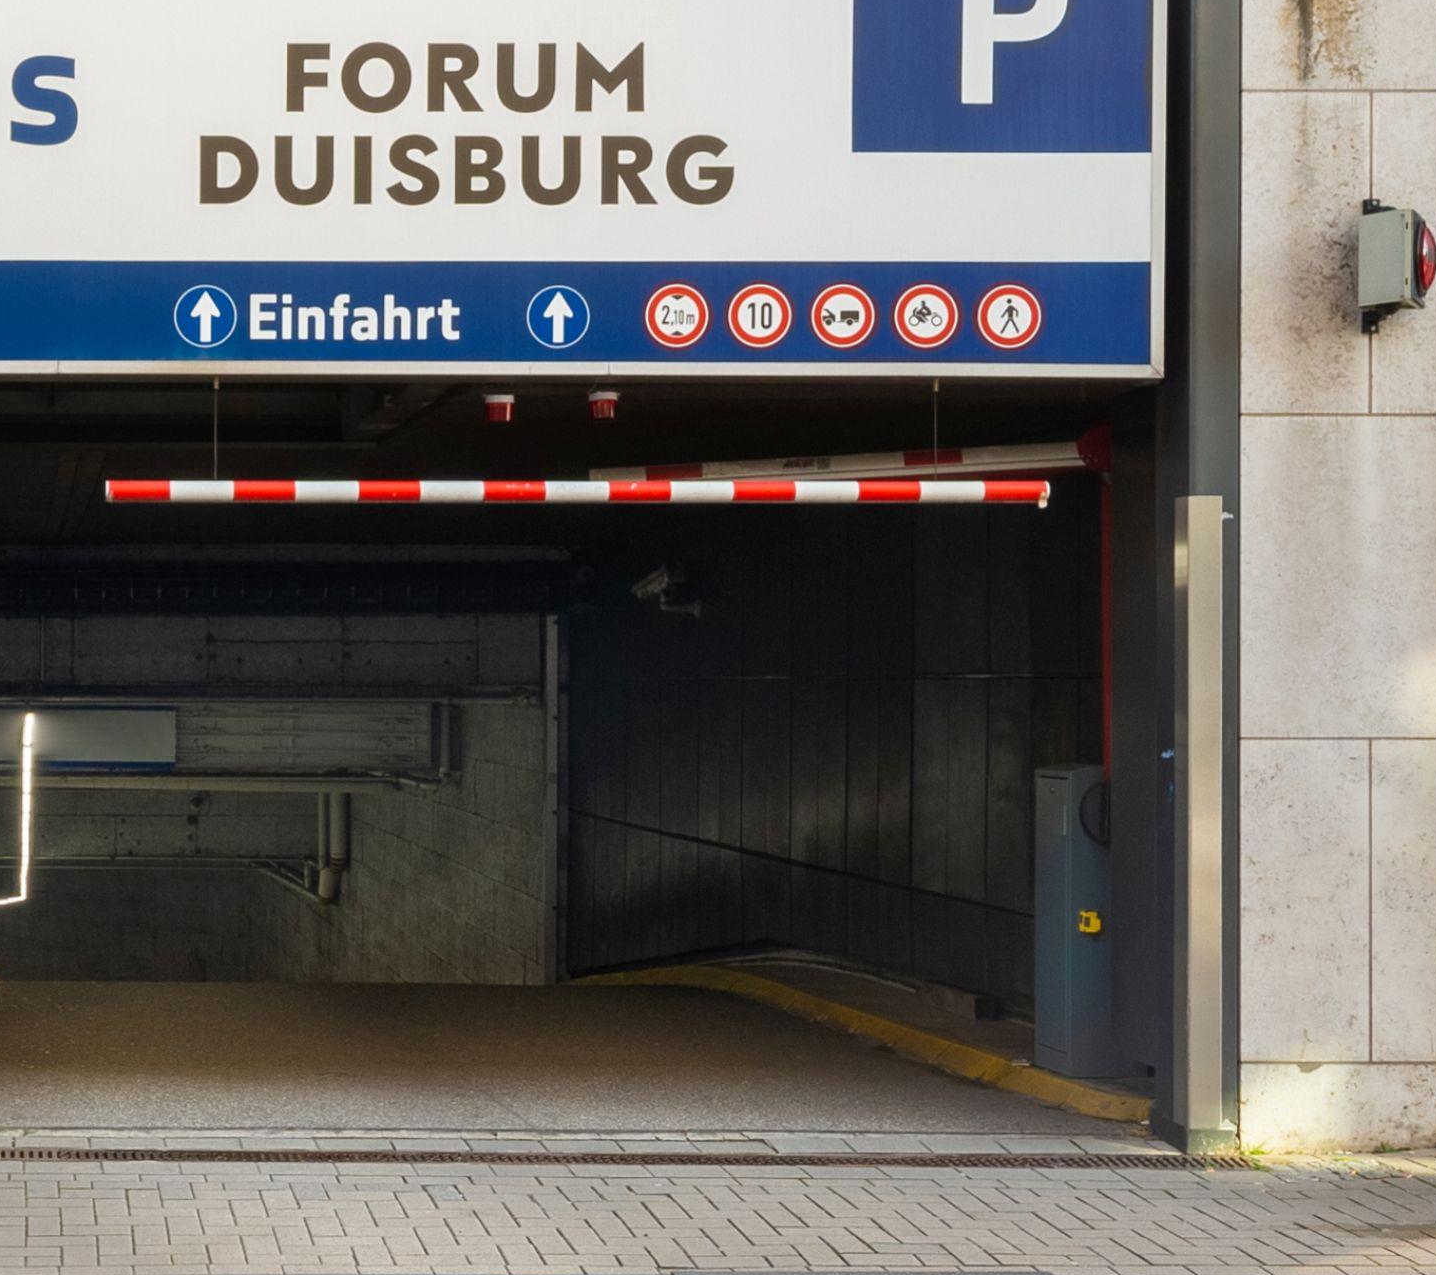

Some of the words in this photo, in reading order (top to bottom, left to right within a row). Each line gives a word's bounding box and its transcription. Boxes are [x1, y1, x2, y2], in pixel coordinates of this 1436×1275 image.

[282, 38, 648, 116] FORUM
[194, 132, 738, 208] DUISBURG
[244, 290, 464, 344] Einfahrt
[661, 305, 684, 326] 2,10
[747, 302, 773, 329] 10
